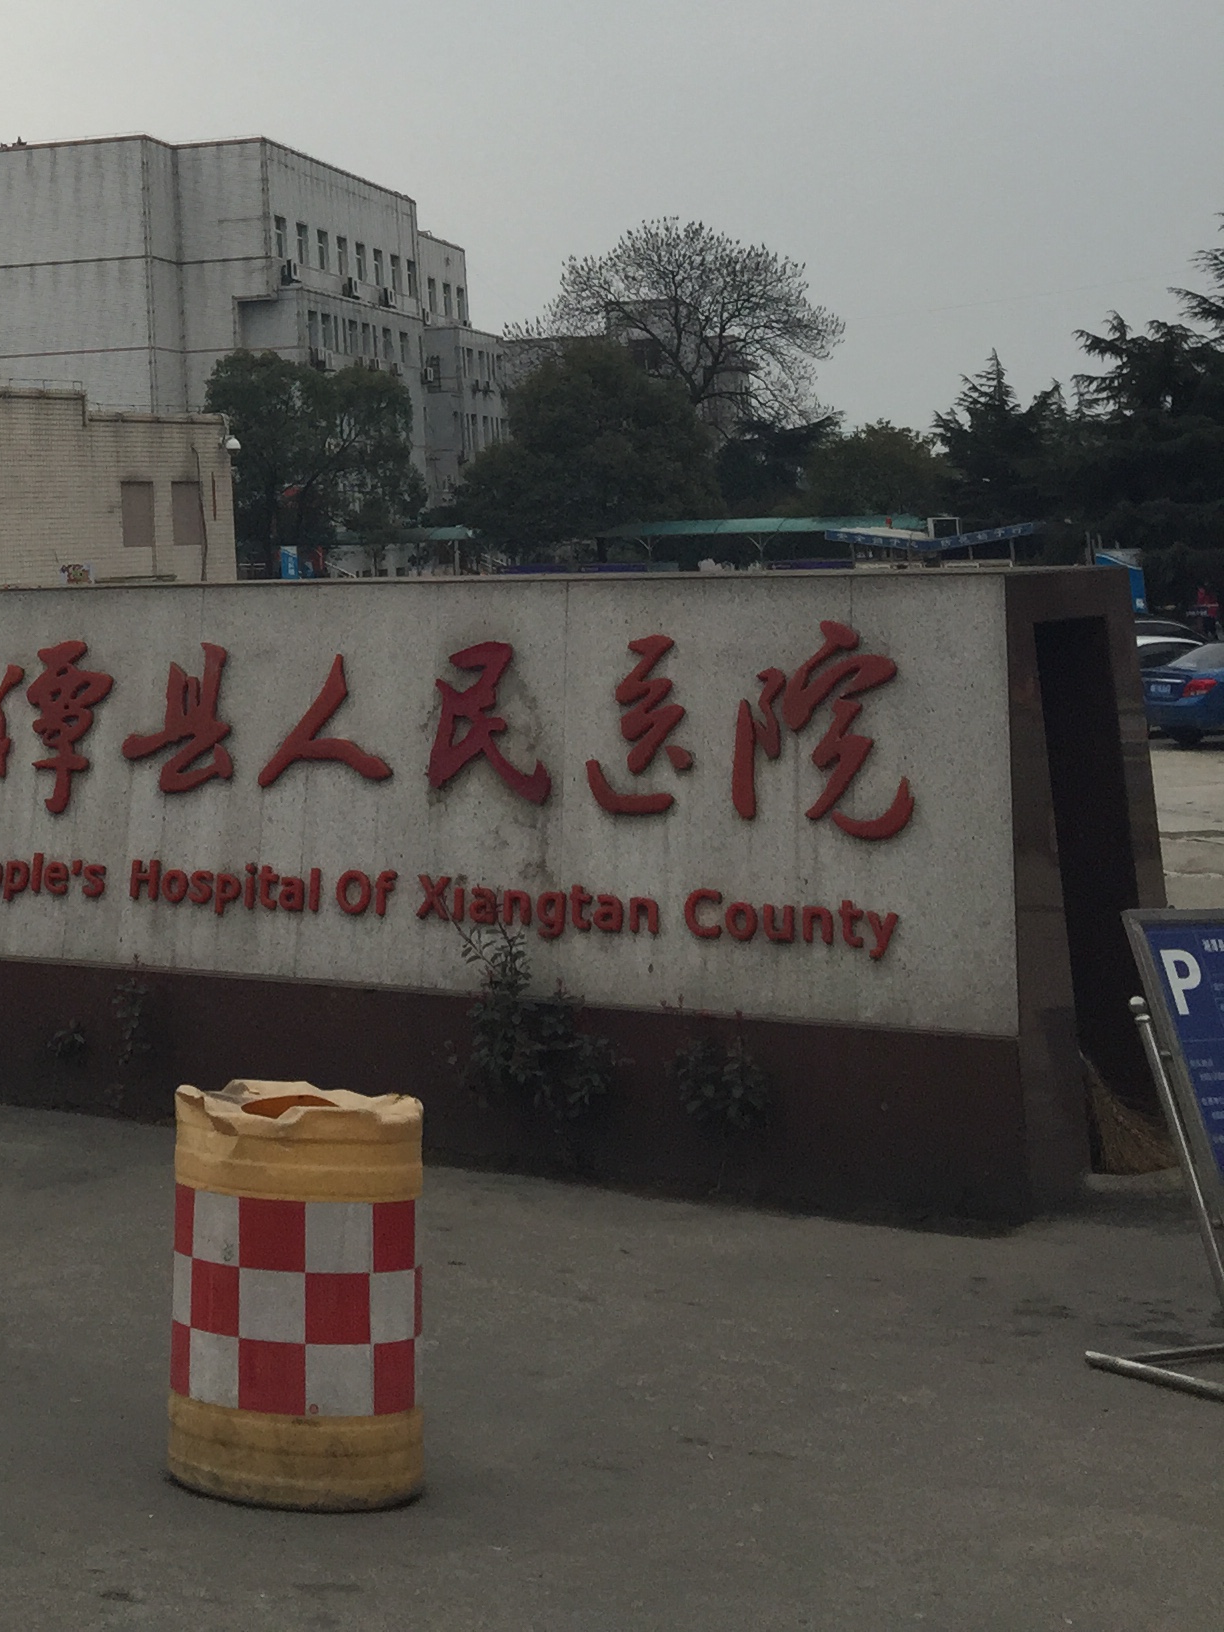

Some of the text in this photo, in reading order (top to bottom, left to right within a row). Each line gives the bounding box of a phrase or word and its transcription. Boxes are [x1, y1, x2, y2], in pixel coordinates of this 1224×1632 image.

[129, 859, 321, 914] Hospital
[336, 869, 397, 916] Of
[416, 873, 660, 939] Xiangtan
[684, 888, 899, 960] County
[1159, 949, 1202, 1015] P
